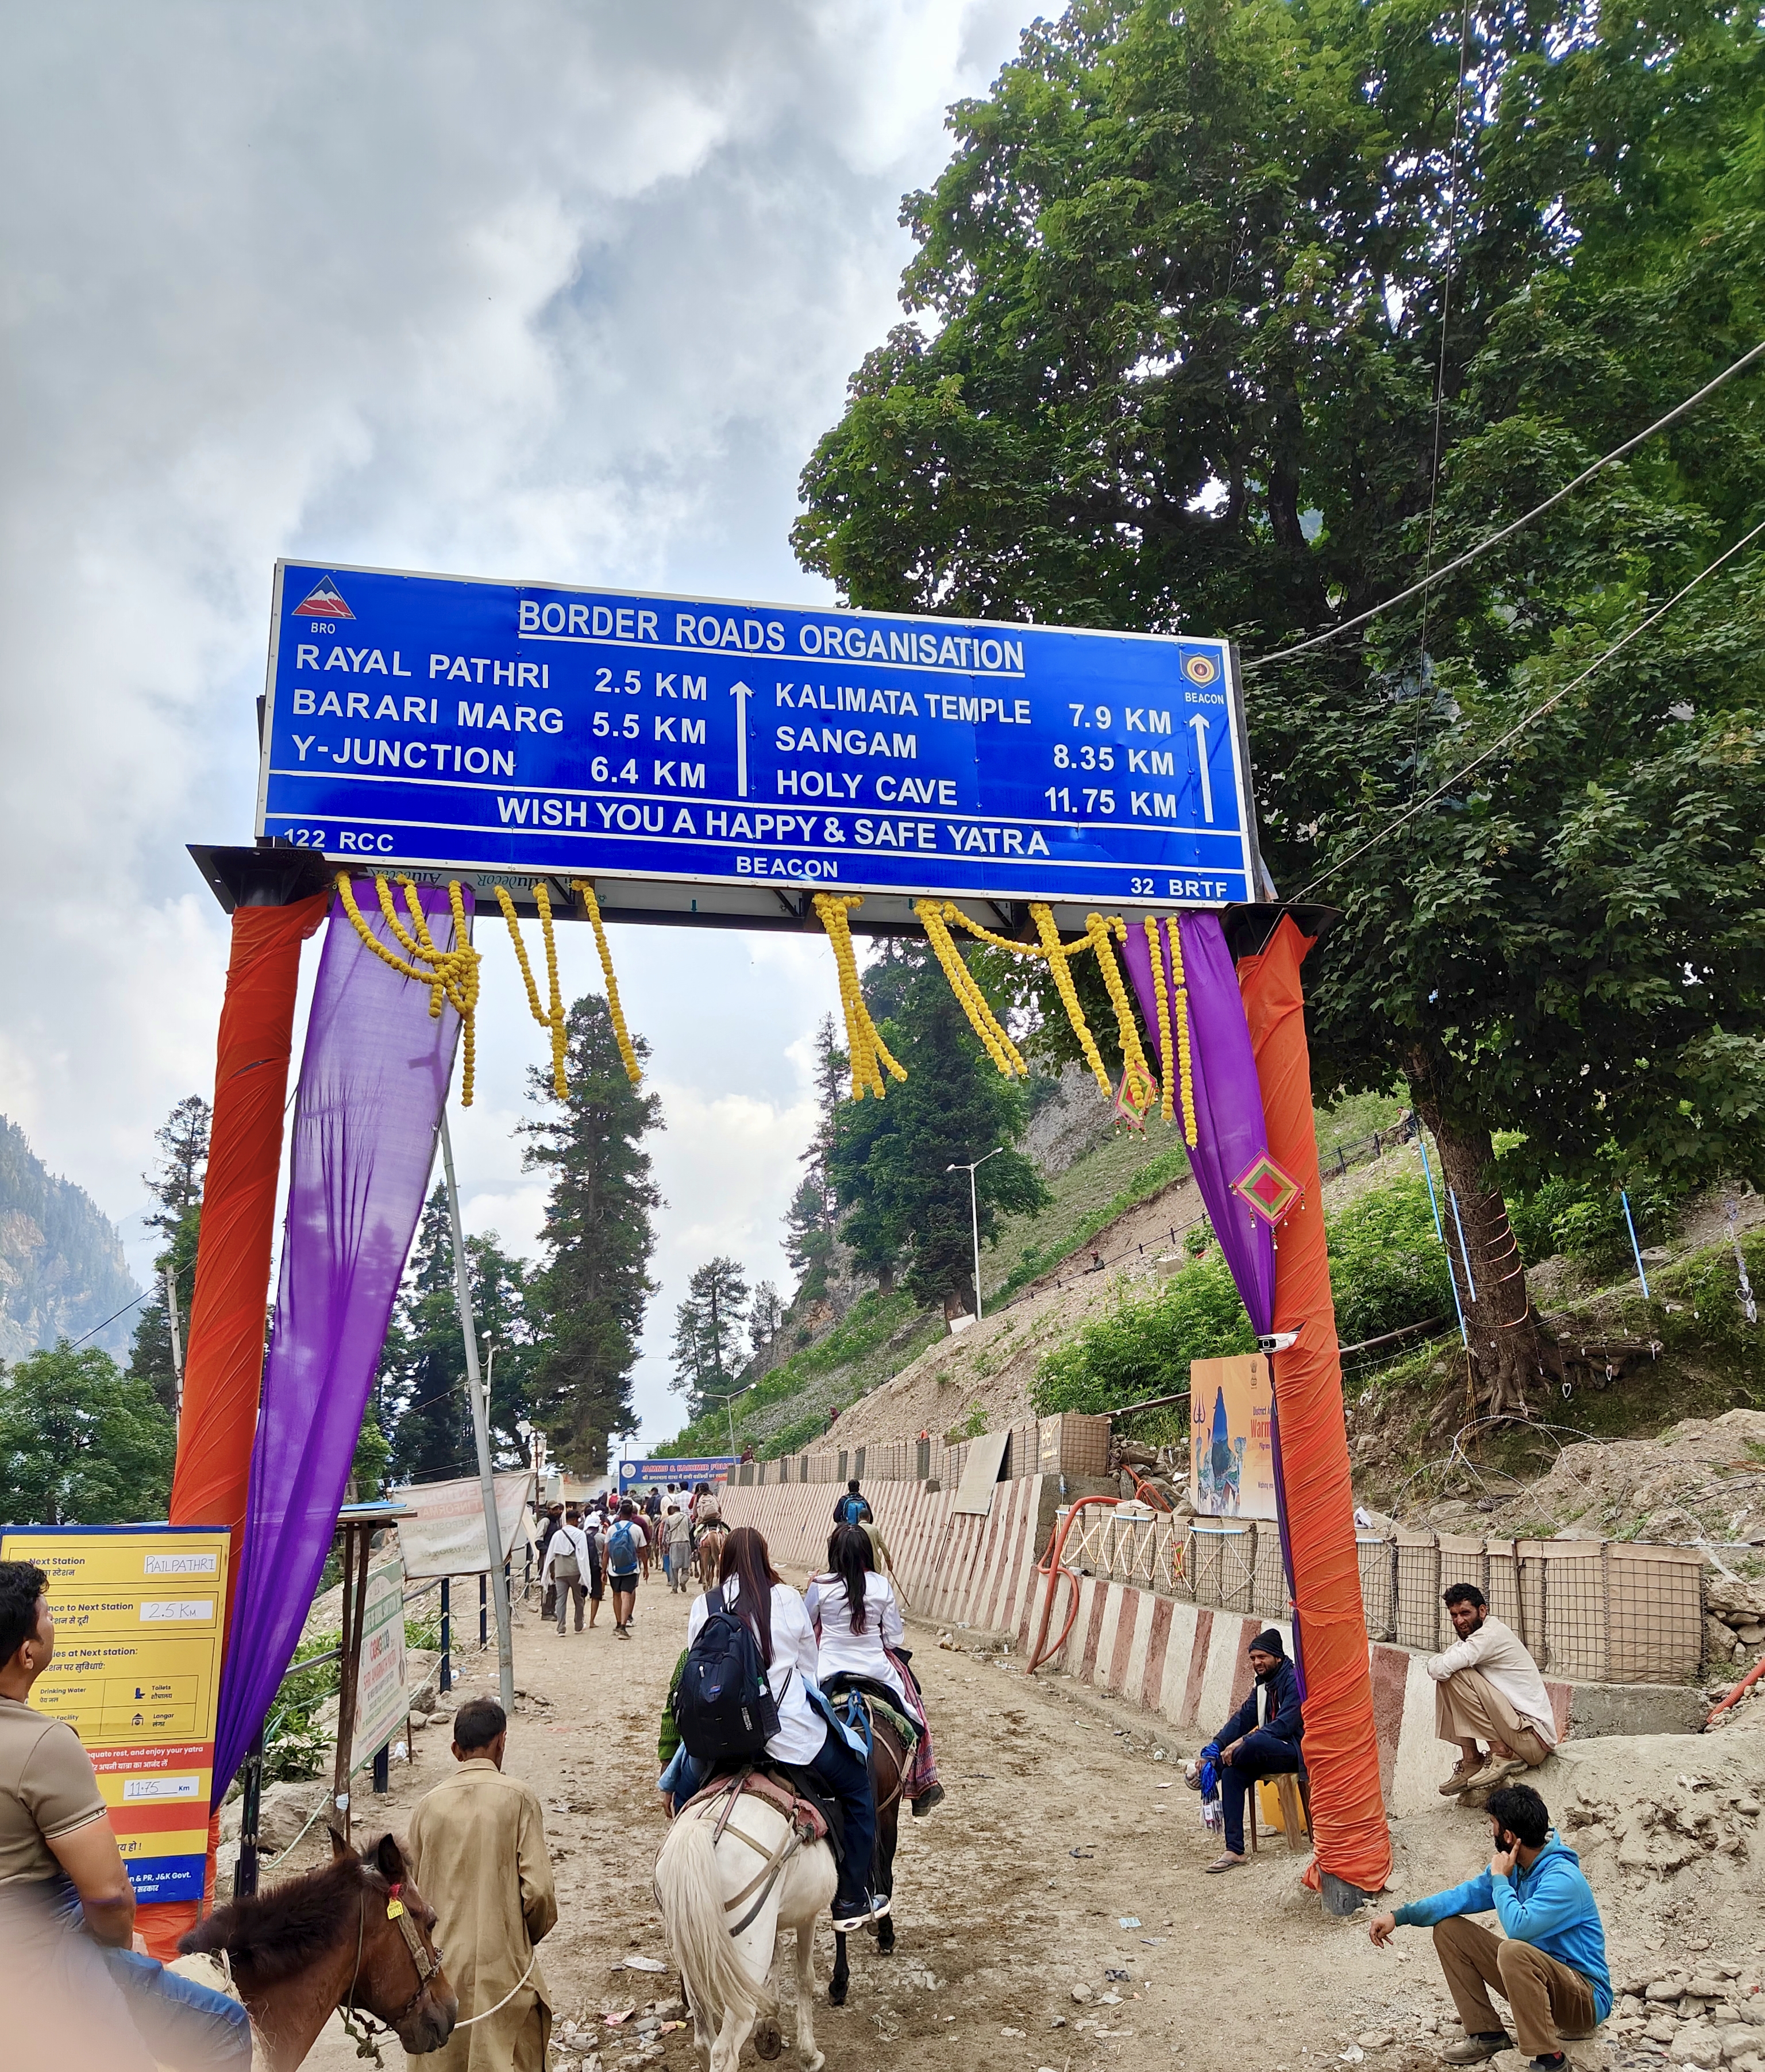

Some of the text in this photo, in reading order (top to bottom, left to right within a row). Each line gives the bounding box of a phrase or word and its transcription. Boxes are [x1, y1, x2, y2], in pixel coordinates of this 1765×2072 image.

[311, 622, 336, 635] BRO
[519, 600, 1024, 671] BORDER ROADS ORGANISATION
[296, 644, 707, 701] RAYAL PATHRI 2.5 KM
[1185, 692, 1225, 705] BEACON
[776, 683, 1171, 735] KALIMATA TEMPLE 7.9 KM
[292, 689, 707, 745] BARARI MARG 5.5 KM
[775, 725, 1175, 777] SANGAM 8.35 KM
[292, 734, 706, 789] Y-JUNCTION 6.4 KM
[777, 769, 1177, 819] HOLY CAVE 11.75 KM
[496, 796, 1051, 856] WISH YOU A HAPPY & SAFE YATRA
[284, 828, 394, 852] 122 RCC
[736, 855, 838, 879] BEACON
[1130, 877, 1228, 898] 32 BRTF
[641, 1465, 669, 1473] JAMMU
[677, 1464, 710, 1472] KASHMIR
[52, 1568, 76, 1577] स्टेशन
[101, 1602, 134, 1611] Station
[148, 1603, 176, 1618] 2.5
[69, 1615, 76, 1624] से
[77, 1615, 89, 1627] दूरी
[80, 1649, 101, 1657] Next
[103, 1647, 138, 1656] station:
[88, 1751, 112, 1760] equate
[145, 1747, 166, 1757] enjoy
[167, 1747, 183, 1756] your
[184, 1747, 204, 1755] yatra
[99, 1762, 117, 1771] अपनी
[143, 1759, 161, 1768] आनंद
[130, 1781, 161, 1795] 11.75
[128, 1840, 137, 1852] हो
[142, 1874, 155, 1882] PR,
[155, 1873, 171, 1881] J&K
[172, 1871, 192, 1880] Govt.
[137, 1885, 160, 1893] सरकार
